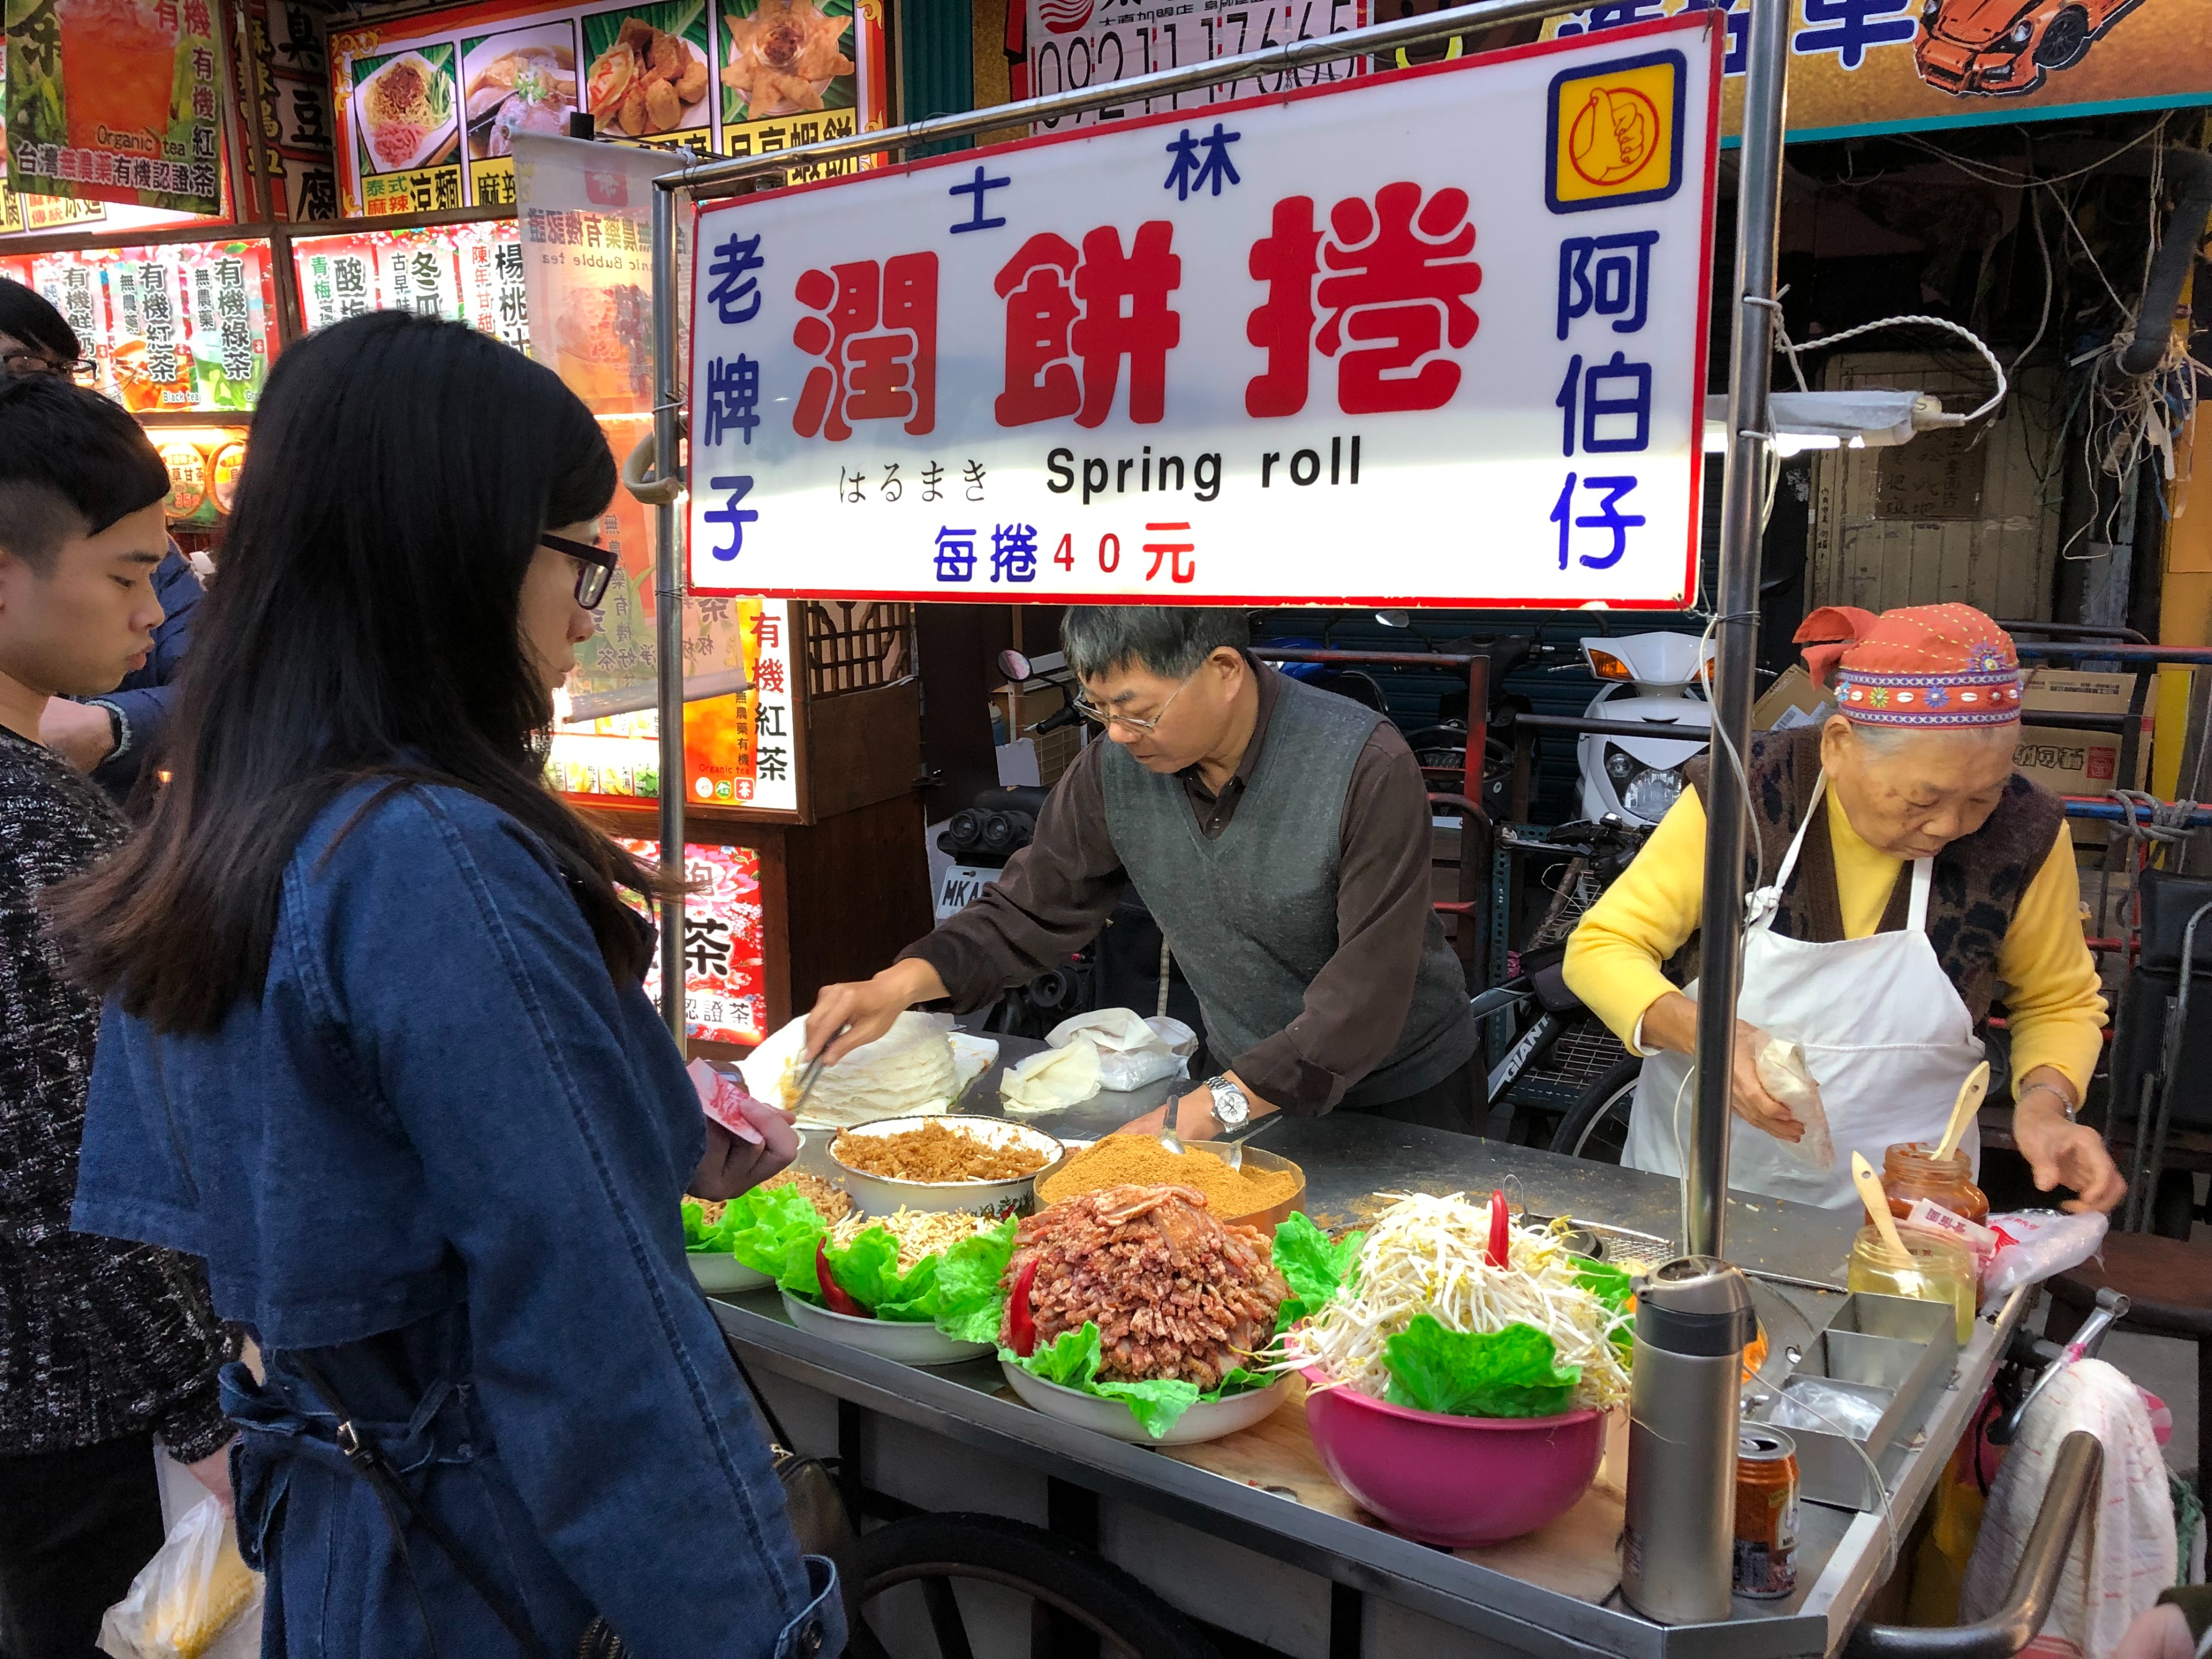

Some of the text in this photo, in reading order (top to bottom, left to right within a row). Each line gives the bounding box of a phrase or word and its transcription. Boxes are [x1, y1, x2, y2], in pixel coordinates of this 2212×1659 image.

[97, 124, 186, 156] Organic tea
[190, 46, 216, 196] 有機紅茶
[366, 177, 408, 196] 泰式
[367, 195, 409, 215] 麻辣
[139, 263, 176, 381] 有機紅茶
[195, 269, 215, 328] 無農藥
[215, 258, 251, 379] 有機綠茶
[472, 246, 493, 331] 陳年甘甜
[792, 181, 1483, 442] 潤餅捲
[164, 392, 200, 402] Black tea
[703, 233, 764, 562] 老牌子
[1550, 230, 1661, 570] 阿伯仔
[839, 458, 987, 504] はるまき
[1047, 435, 1362, 505] Spring roll
[933, 521, 1196, 583] 每捲40元
[735, 692, 750, 766] 無農藥有機
[750, 612, 788, 781] 有機紅茶
[699, 764, 750, 774] Organic tea
[1504, 1015, 1549, 1083] GIANT
